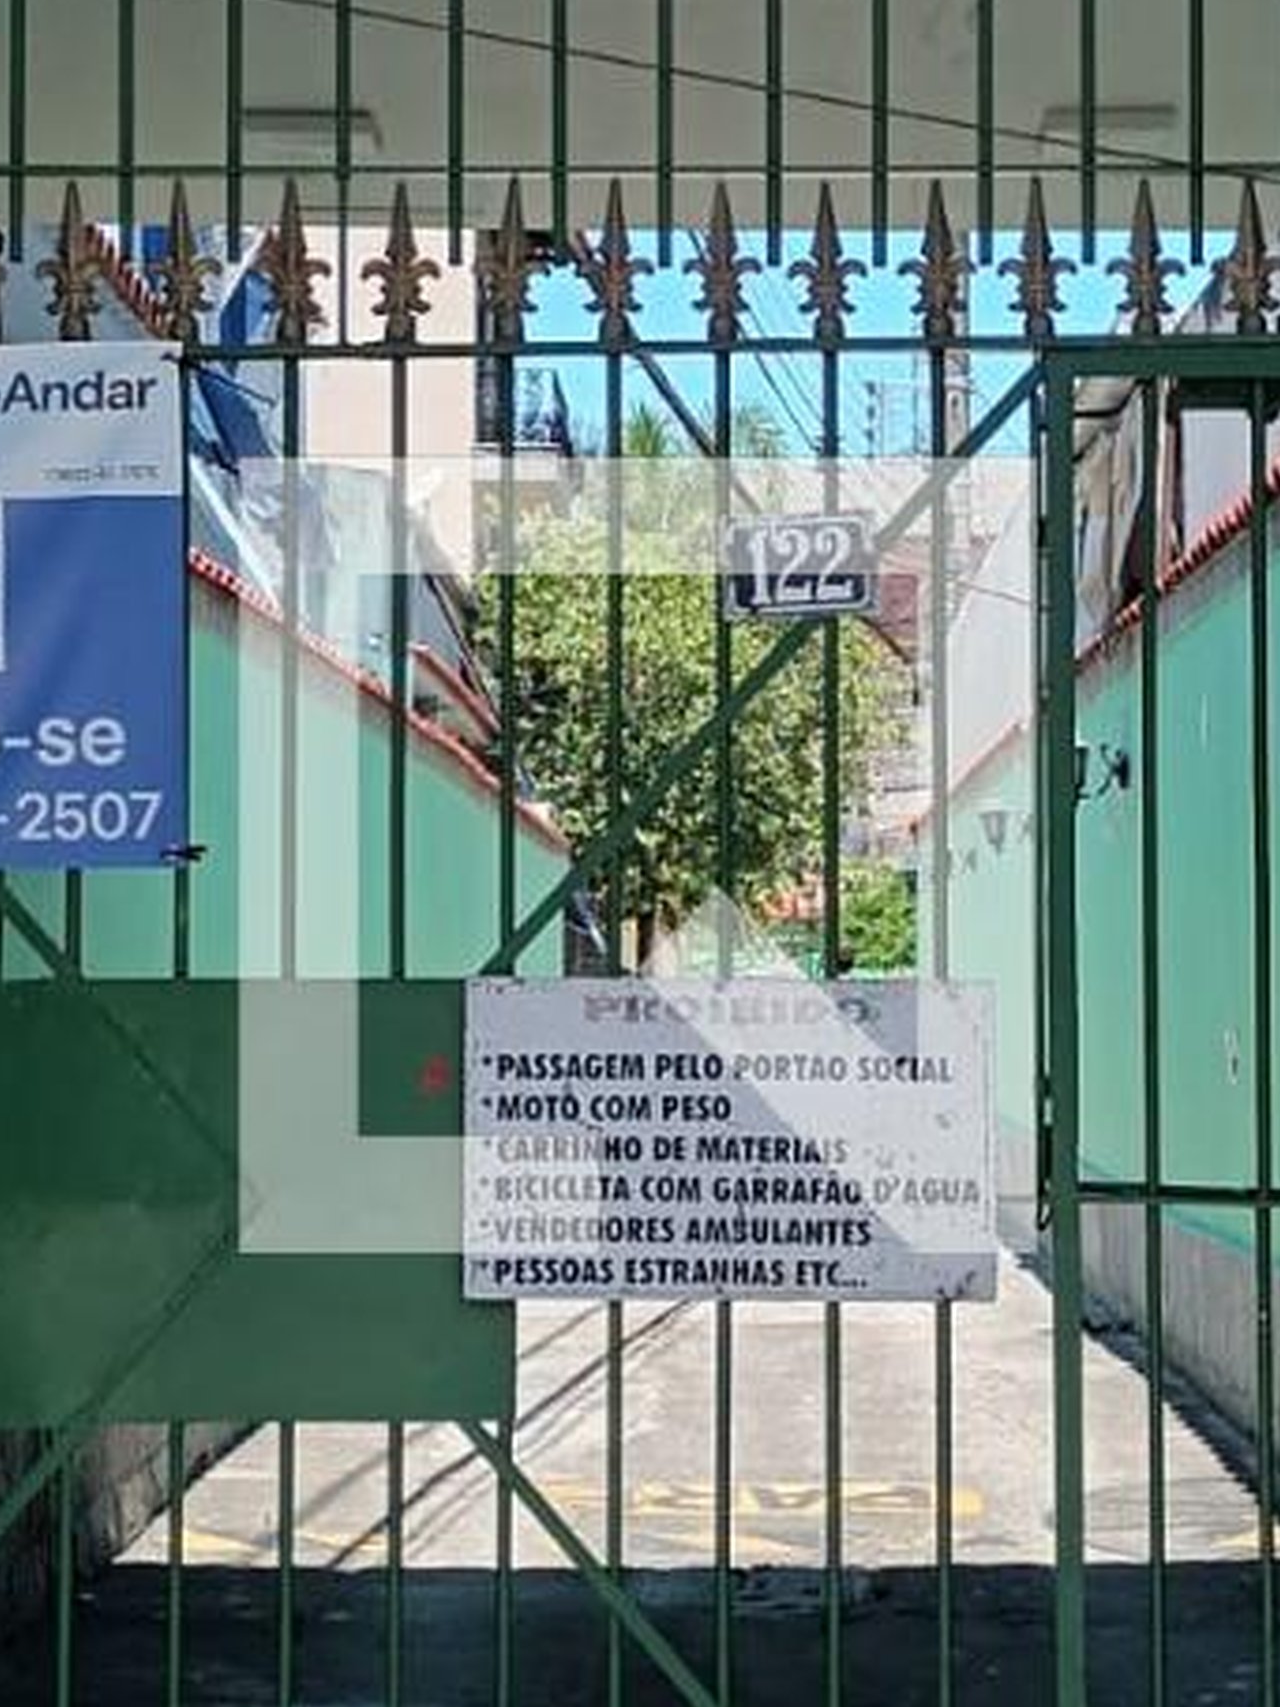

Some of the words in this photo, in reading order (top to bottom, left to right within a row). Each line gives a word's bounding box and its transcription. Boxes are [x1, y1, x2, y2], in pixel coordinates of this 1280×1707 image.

[746, 525, 855, 605] 122
[496, 1053, 645, 1082] PASSAGEM
[655, 1053, 724, 1082] PELO
[857, 1054, 954, 1083] SOCIAL
[589, 1094, 652, 1122] COM
[662, 1094, 732, 1122] PESO
[496, 1135, 643, 1163] CARRINHO
[652, 1136, 687, 1162] DE
[696, 1135, 848, 1164] MATERIAIS
[495, 1175, 630, 1203] BICICLETA
[641, 1175, 702, 1203] COM
[494, 1216, 675, 1244] VENDEDORES
[685, 1217, 872, 1247] AMBULANTES
[494, 1257, 614, 1285] PESSOAS
[624, 1257, 785, 1286] ESTRANHAS
